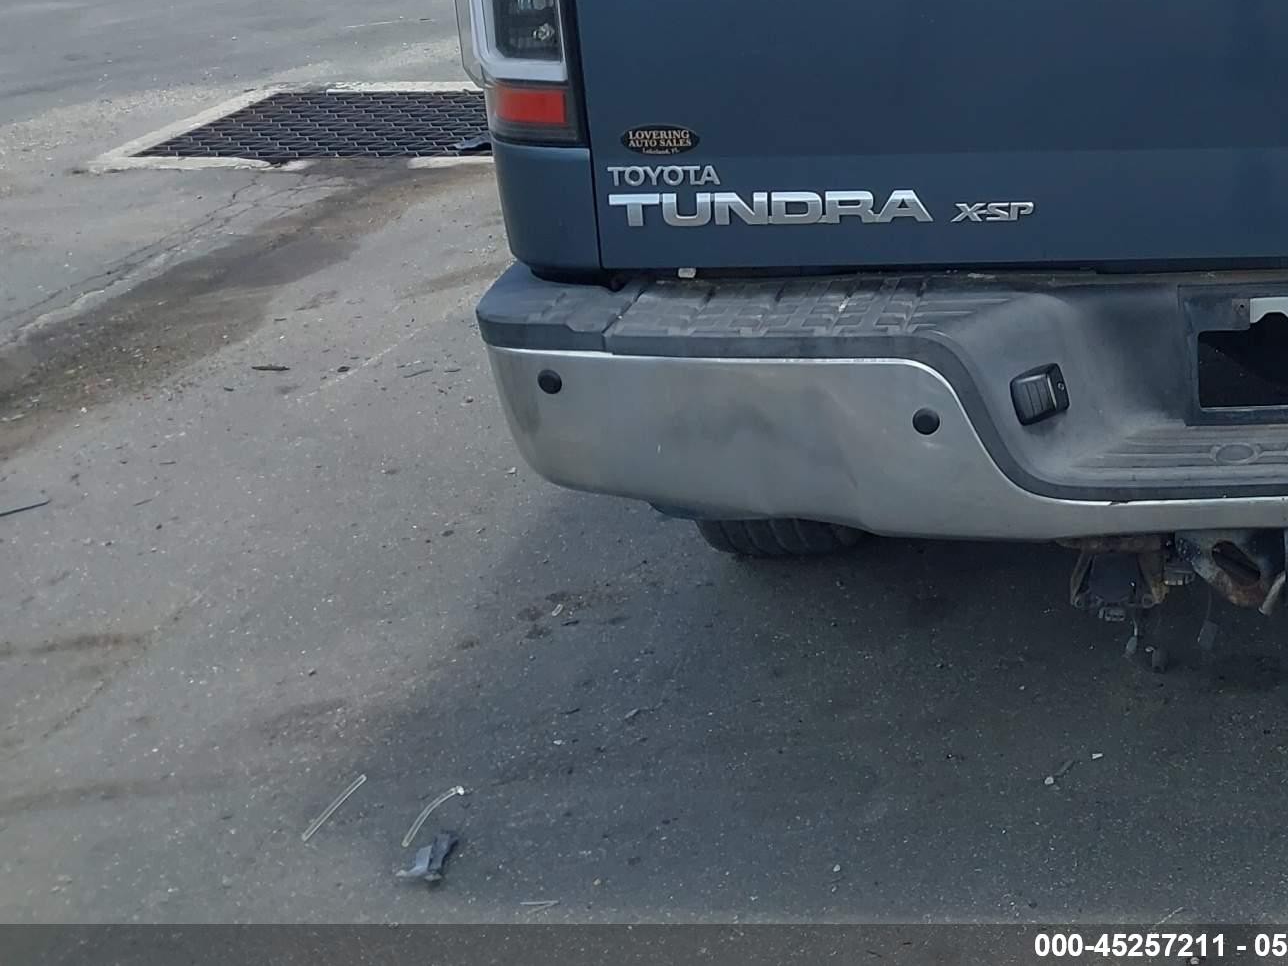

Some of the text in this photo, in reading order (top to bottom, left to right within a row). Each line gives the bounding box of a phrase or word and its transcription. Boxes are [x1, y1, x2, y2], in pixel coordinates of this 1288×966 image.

[628, 130, 690, 140] LOVERING
[628, 138, 692, 148] AUTO SALES
[607, 165, 721, 187] TOYOTA
[608, 189, 1035, 227] TUNDRA X-SP
